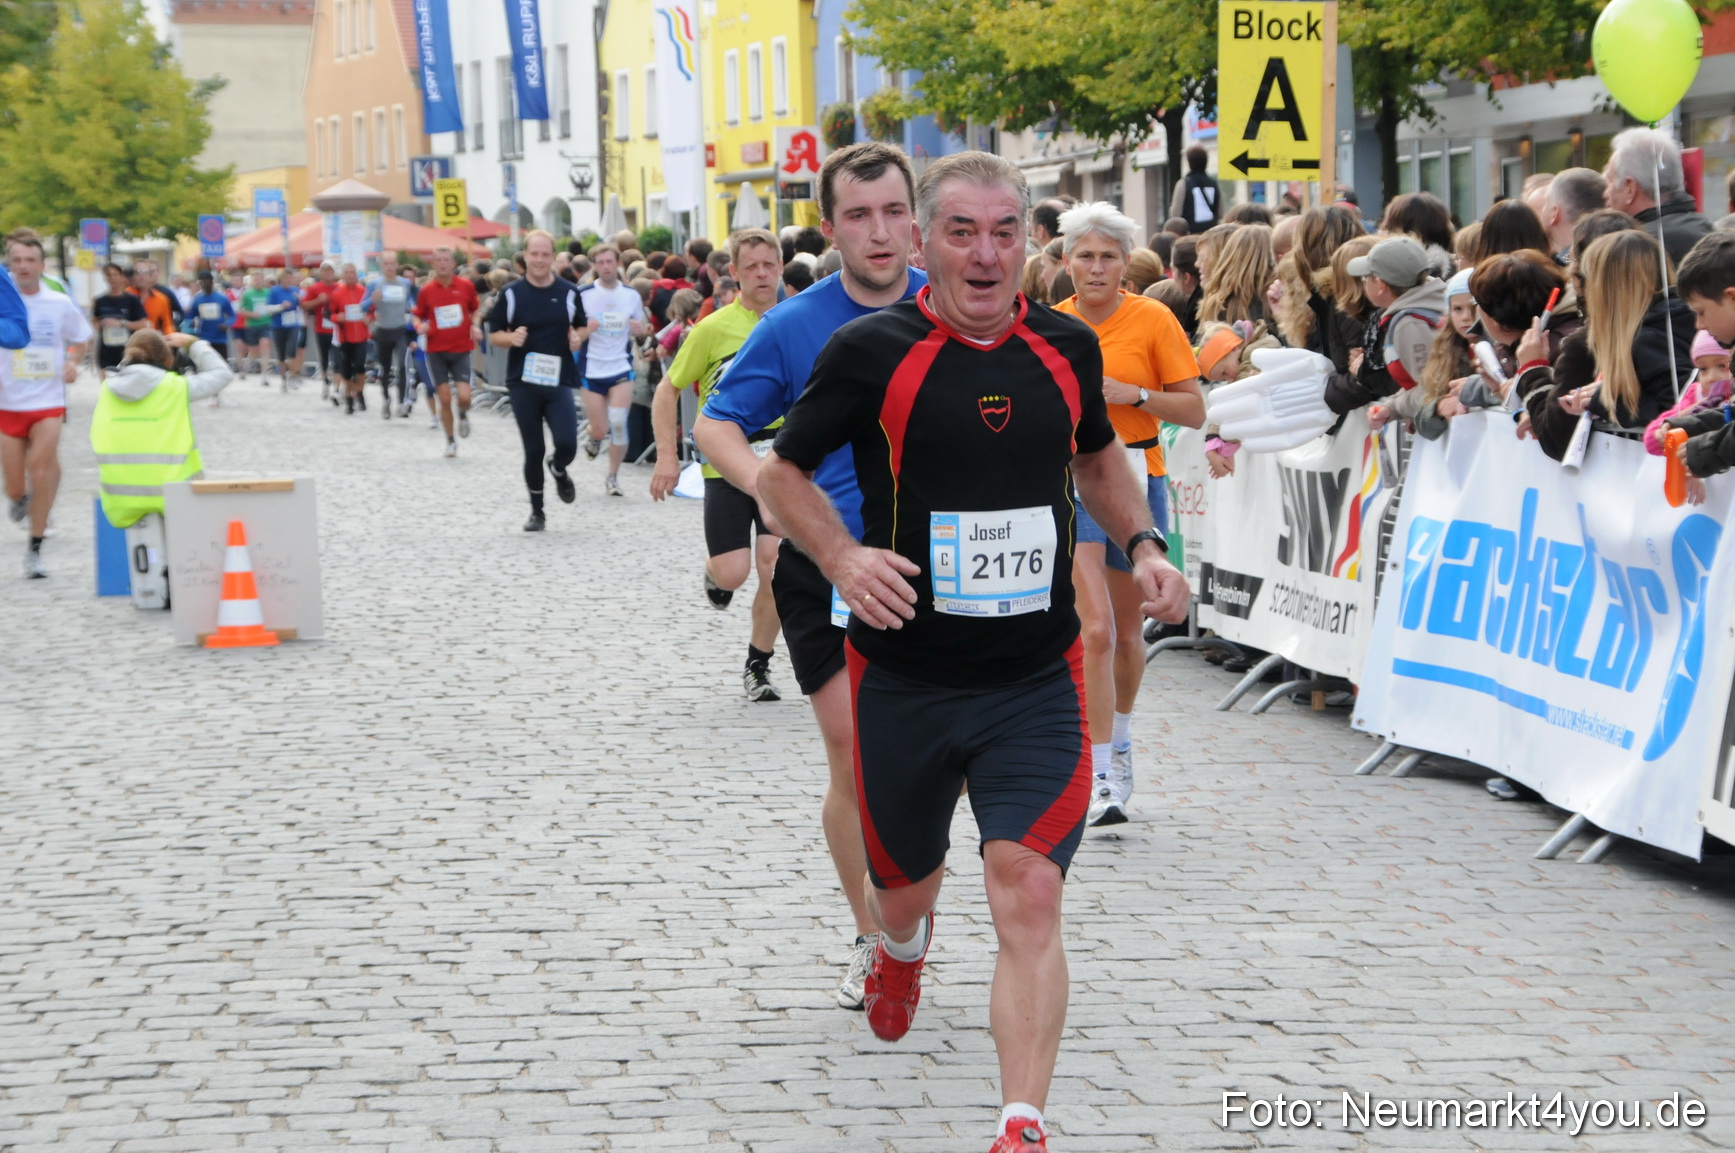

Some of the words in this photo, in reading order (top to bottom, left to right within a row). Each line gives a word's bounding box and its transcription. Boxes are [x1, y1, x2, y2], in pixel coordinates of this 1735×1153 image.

[1234, 10, 1322, 41] Block
[524, 49, 541, 88] K&L
[1242, 57, 1308, 141] A
[444, 194, 460, 216] B
[202, 244, 223, 254] TAXI
[969, 521, 1011, 541] Josef
[941, 552, 949, 566] C
[971, 548, 1043, 580] 2176
